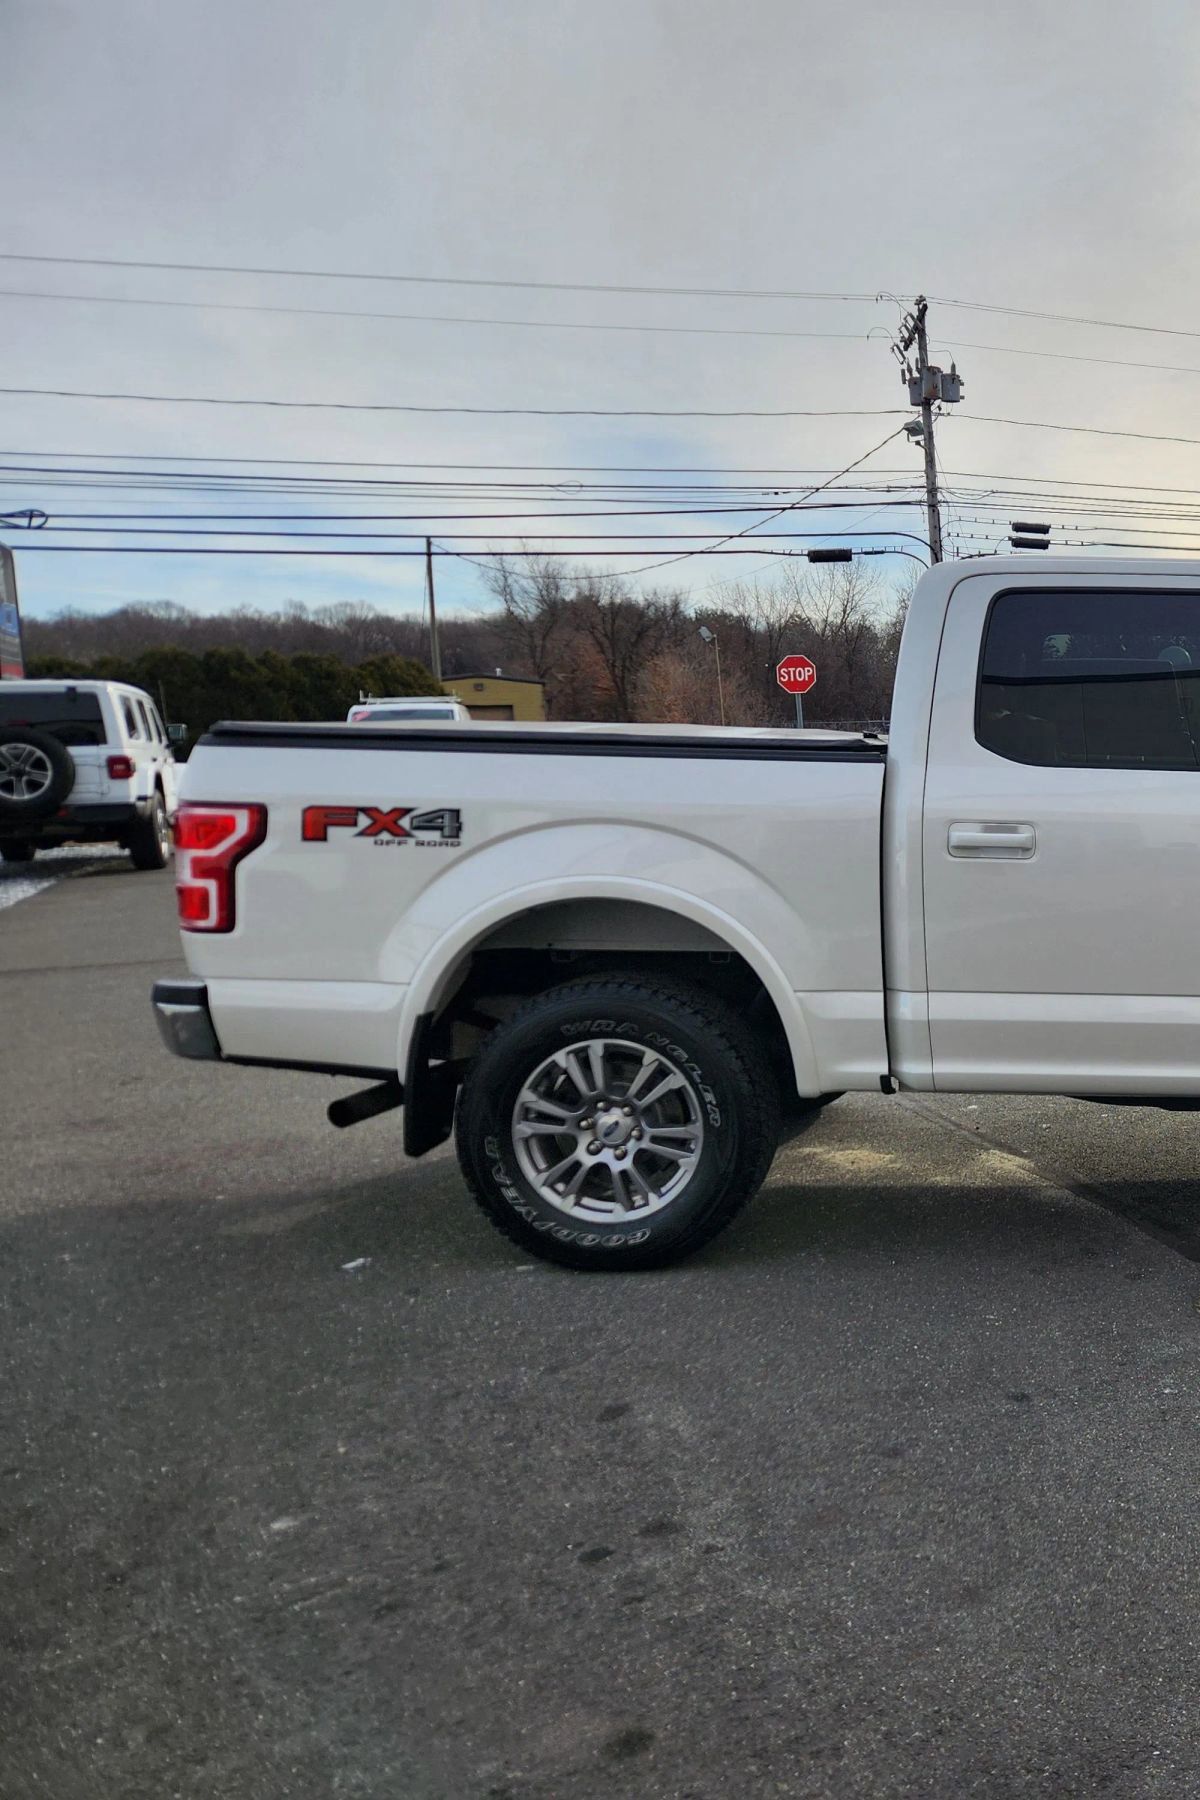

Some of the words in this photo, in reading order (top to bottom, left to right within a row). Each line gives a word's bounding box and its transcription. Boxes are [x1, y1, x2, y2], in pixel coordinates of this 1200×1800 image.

[780, 667, 813, 682] STOP
[301, 805, 463, 841] FX4
[373, 838, 408, 846] OFF
[415, 839, 462, 847] ROAD
[560, 1019, 721, 1127] WRANGLER
[484, 1136, 651, 1246] GOODYEAR
